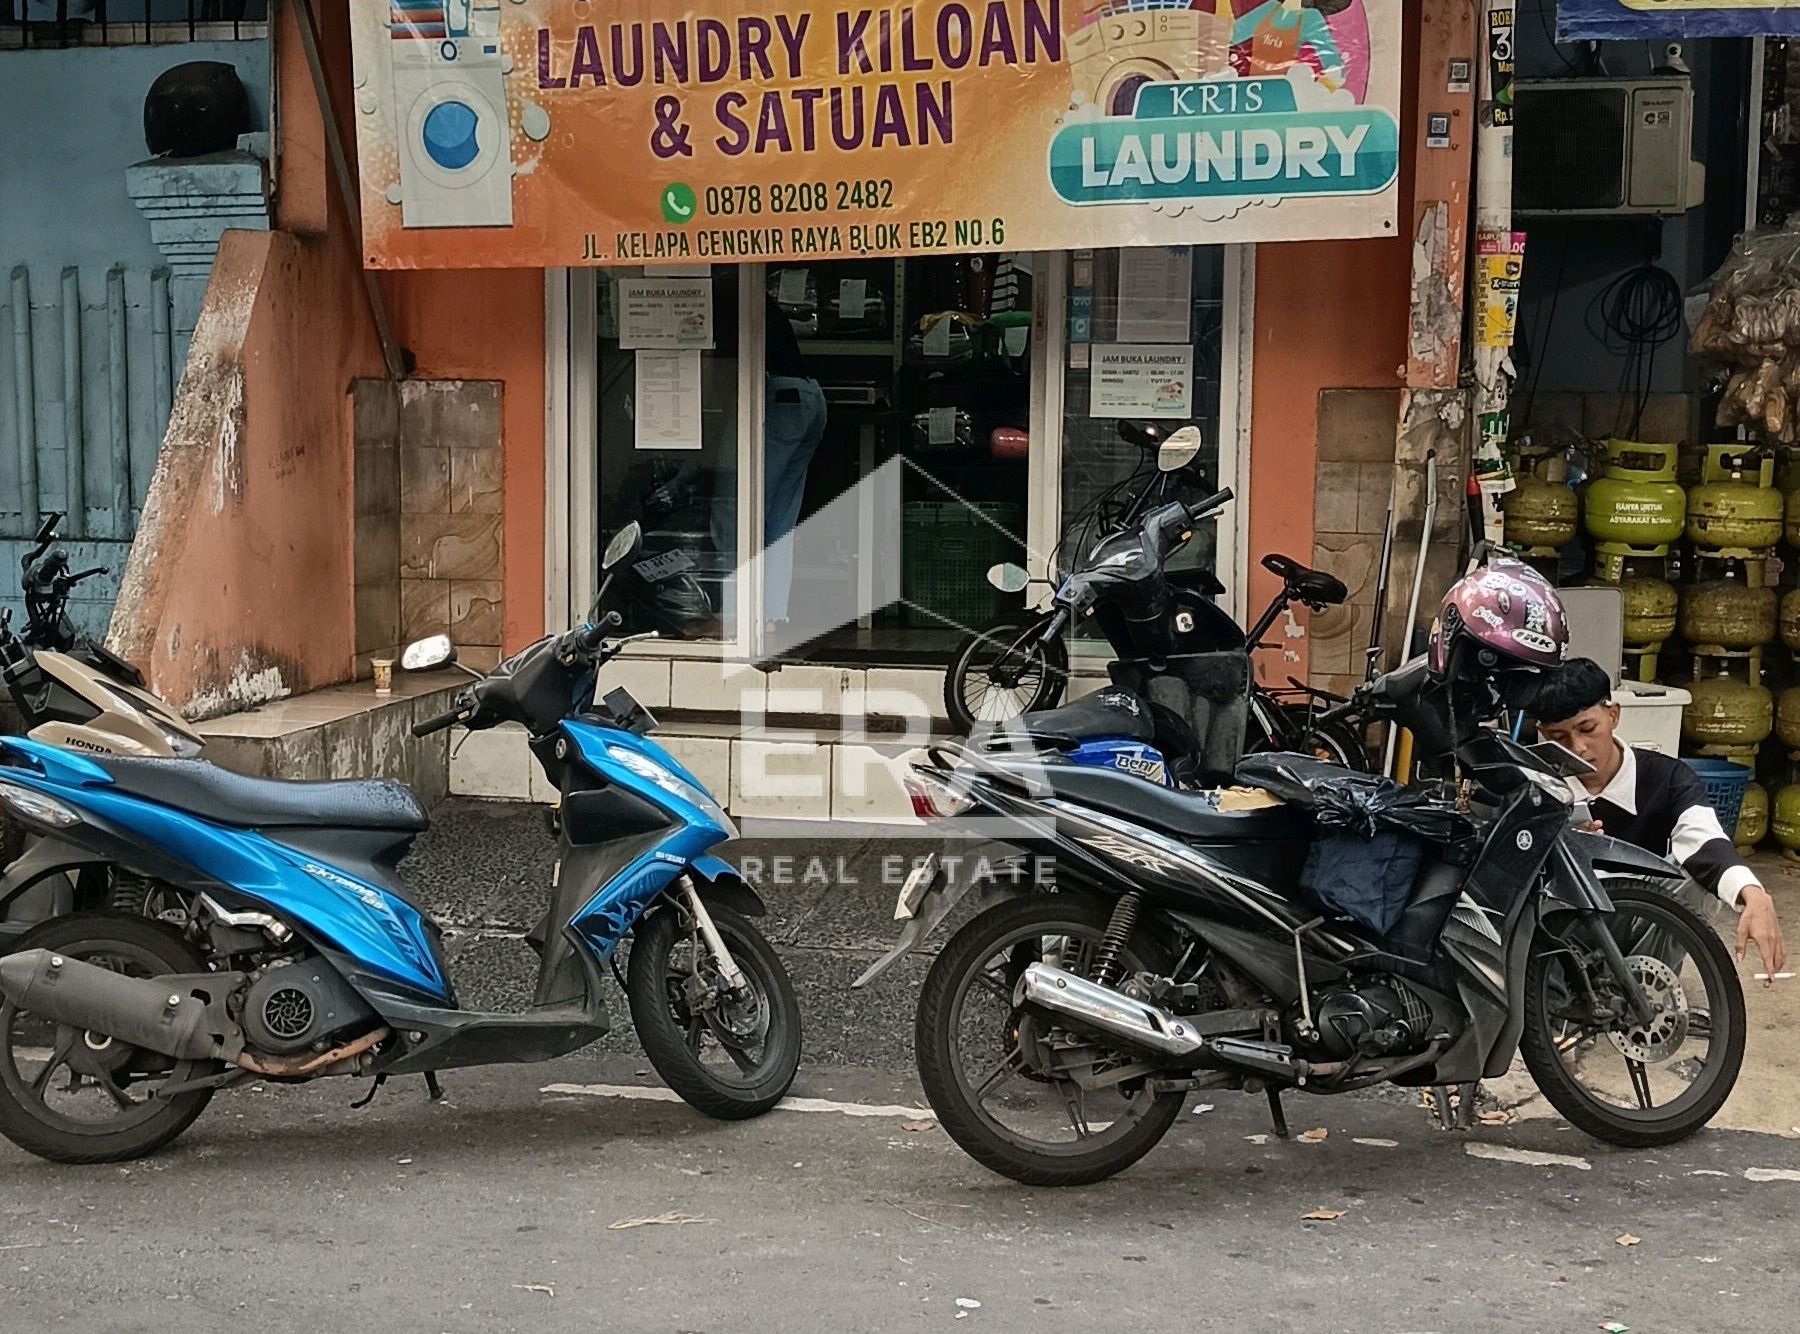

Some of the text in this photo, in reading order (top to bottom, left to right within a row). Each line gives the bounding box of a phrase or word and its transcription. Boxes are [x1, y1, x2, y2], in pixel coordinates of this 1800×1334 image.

[538, 14, 811, 89] LAUNDRY
[1169, 82, 1264, 116] KRIS
[651, 81, 952, 158] & SATUAN
[1081, 124, 1371, 188] LAUNDRY
[706, 179, 893, 216] 0878 8208 2482
[582, 218, 1004, 259] JL. KELAPA CENGKIR RAYA BLOK EB2 NO.6
[667, 289, 701, 298] LAUNDRY
[1102, 355, 1120, 364] JAM
[1120, 355, 1143, 364] BUKA
[1144, 355, 1182, 364] LAUNDRY
[1516, 631, 1552, 648] INK
[65, 736, 112, 754] HONDA
